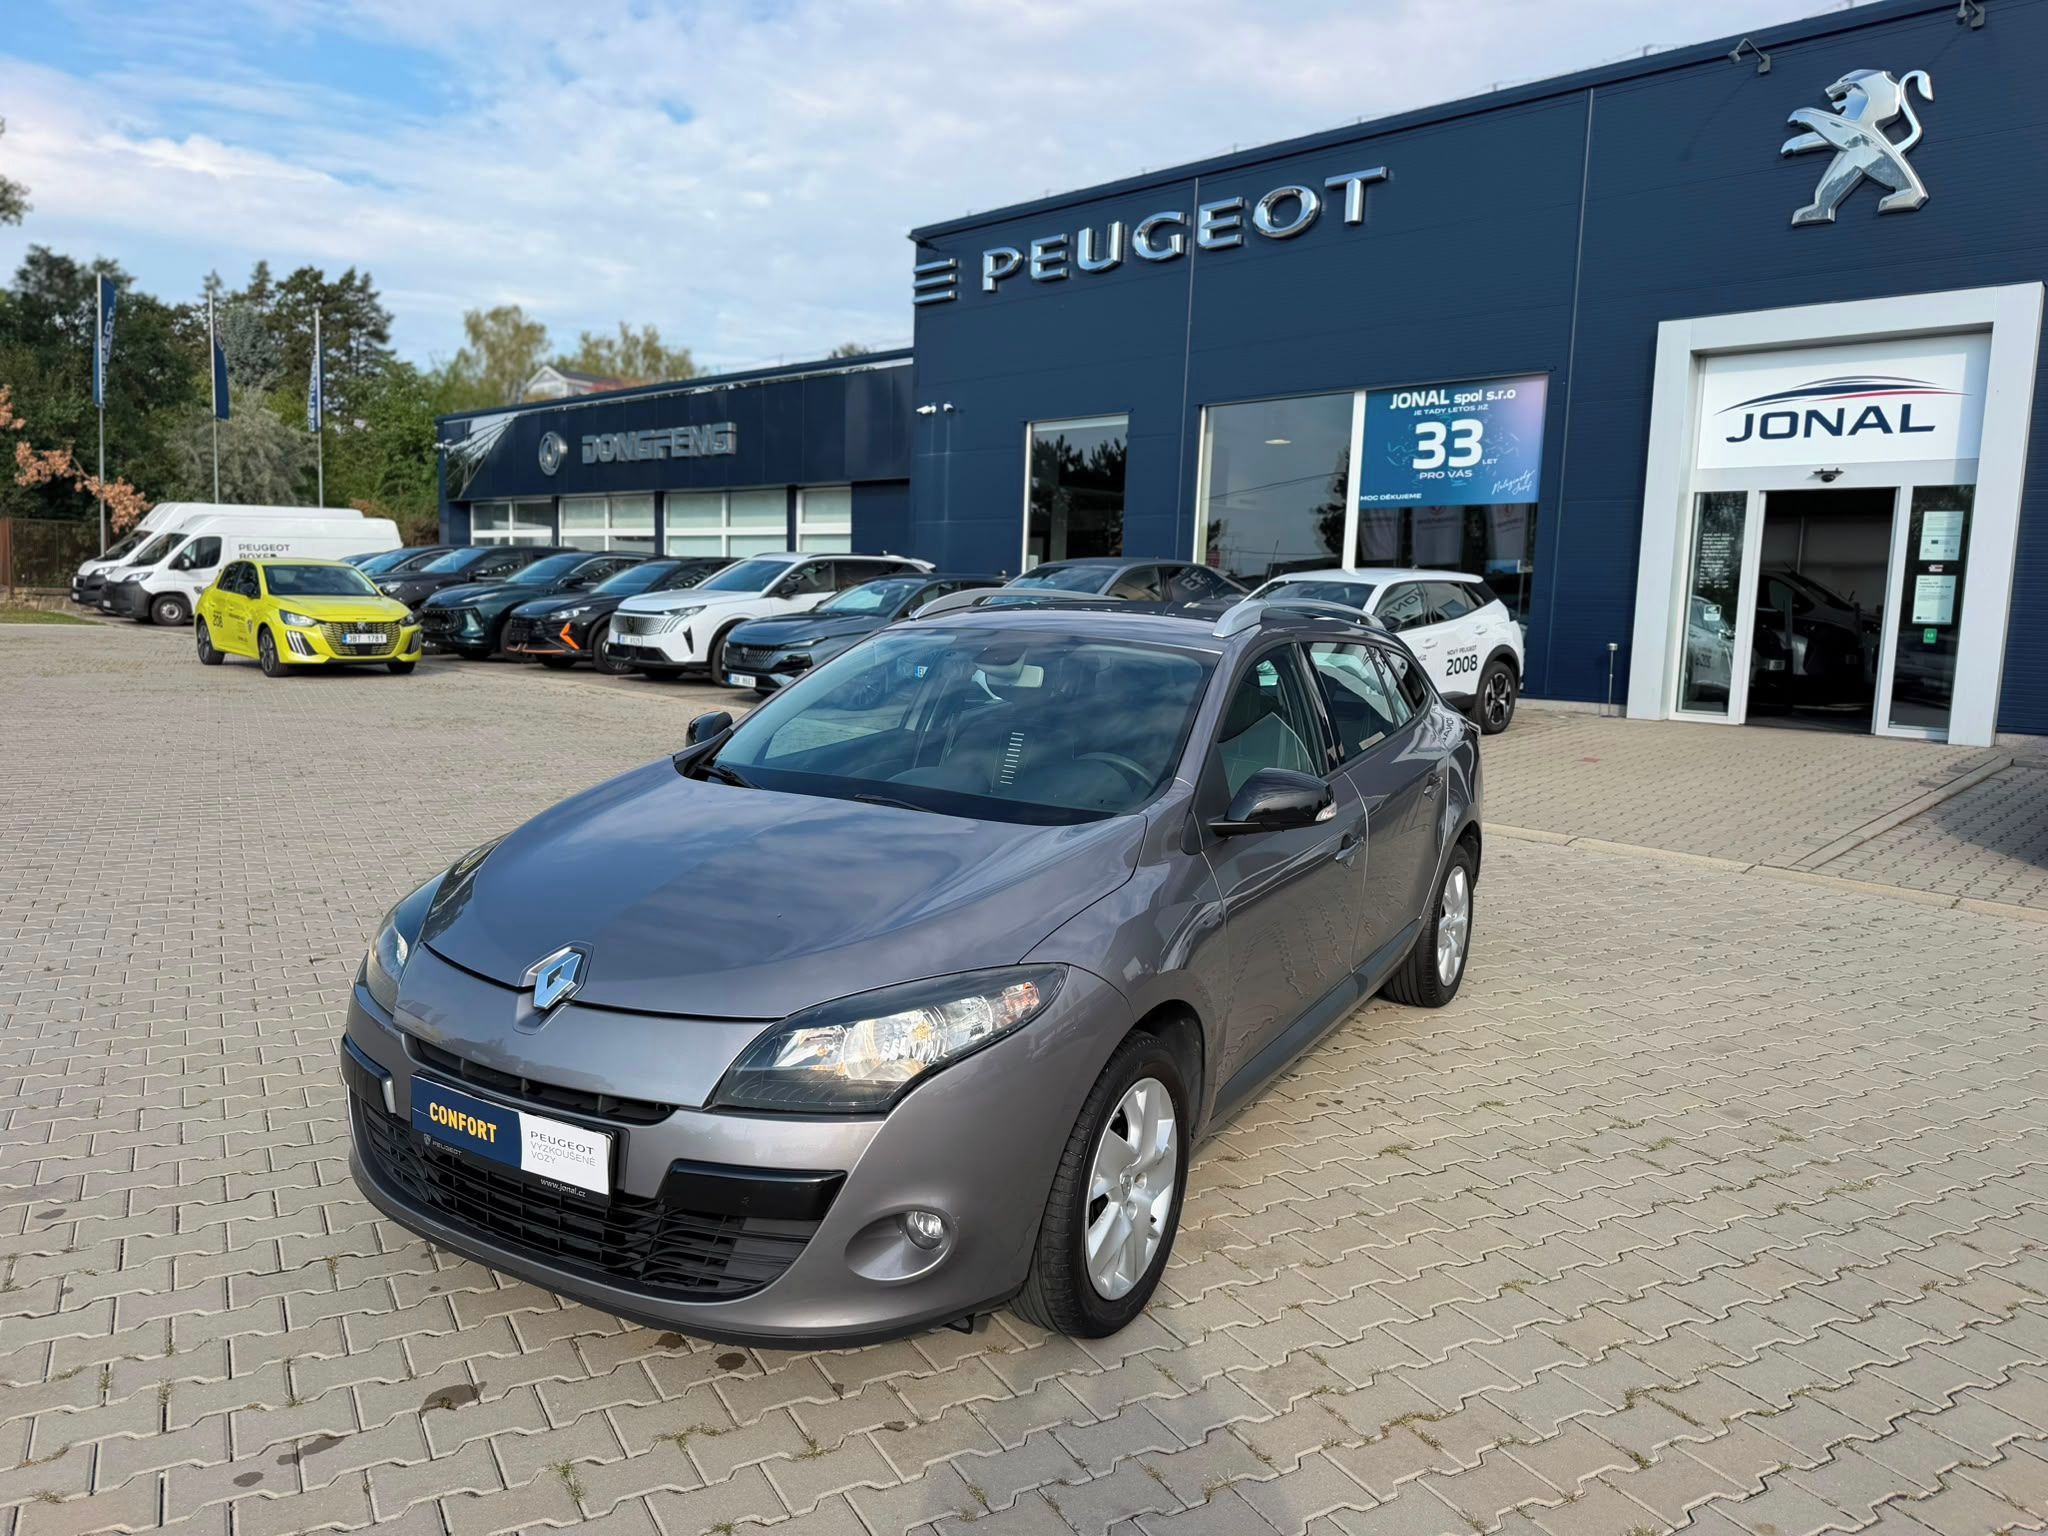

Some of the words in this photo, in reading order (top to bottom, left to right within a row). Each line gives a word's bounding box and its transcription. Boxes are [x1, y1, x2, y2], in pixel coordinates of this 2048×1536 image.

[981, 166, 1388, 292] PEUGEOT
[1389, 389, 1450, 410] JONAL
[1453, 389, 1483, 406] spol
[1424, 407, 1447, 415] TADY
[1447, 405, 1476, 413] LETOS
[1725, 403, 1936, 443] JONAL
[582, 422, 737, 465] DONGFENG
[1412, 418, 1484, 470] 33
[1419, 471, 1445, 480] PRO
[1447, 469, 1473, 479] VÁS
[238, 543, 291, 552] PEUGEOT
[239, 552, 277, 560] BOXE
[1446, 654, 1478, 677] 2008
[429, 1101, 497, 1144] CONFORT
[530, 1130, 594, 1155] PEUGEOT
[531, 1150, 556, 1165] VOZY
[540, 1177, 587, 1199] www.jonal.cz
